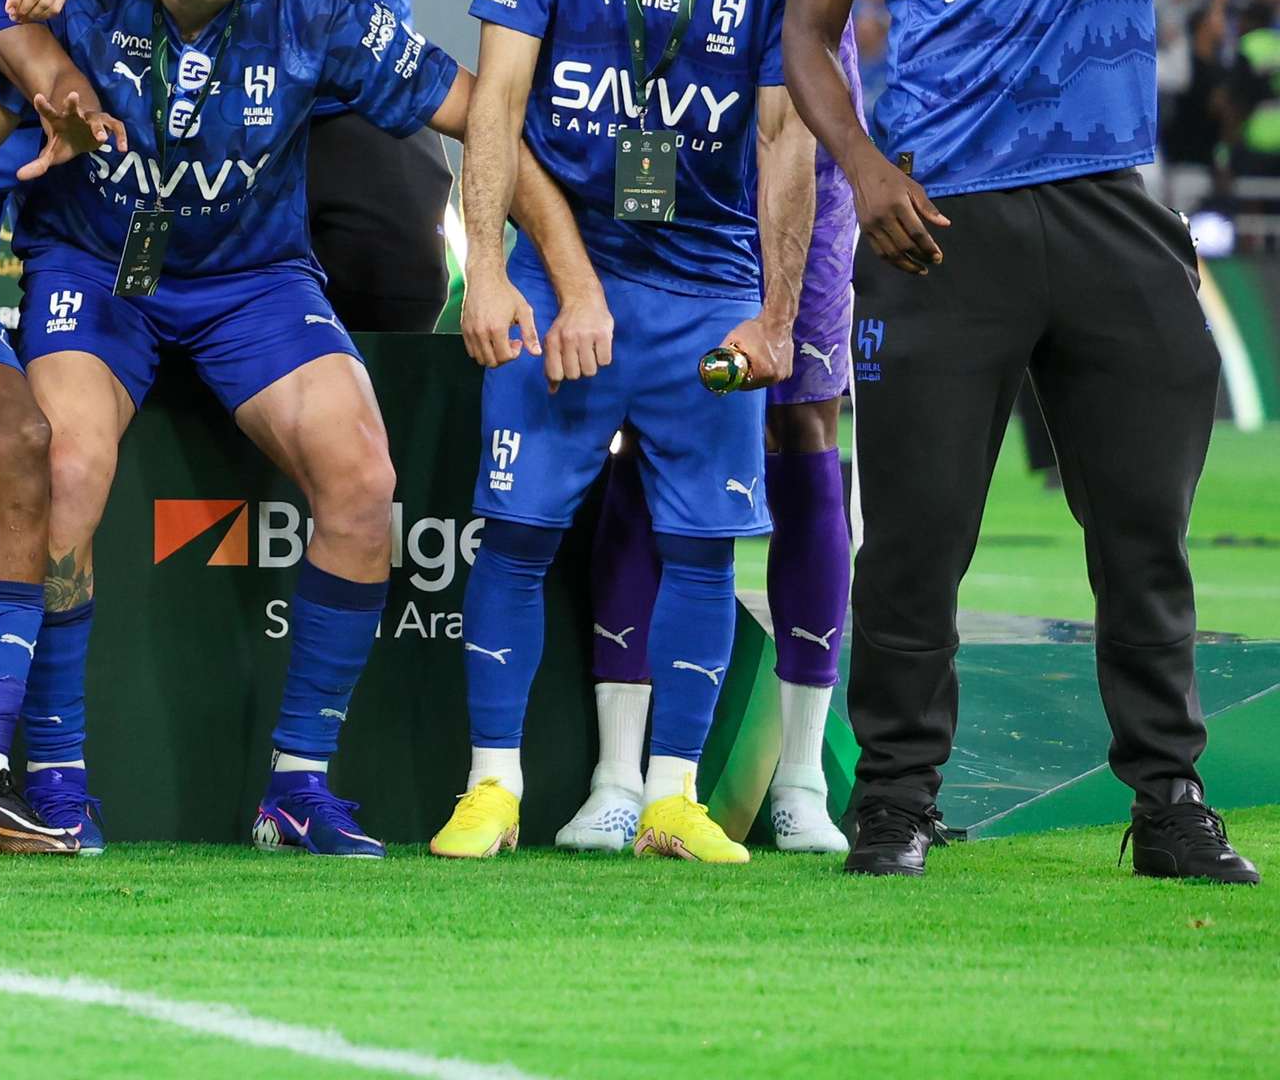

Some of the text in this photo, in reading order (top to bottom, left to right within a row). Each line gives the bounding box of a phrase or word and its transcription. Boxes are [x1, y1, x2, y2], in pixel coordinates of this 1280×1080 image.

[361, 22, 379, 48] Red
[243, 107, 274, 117] ALHILAL
[552, 60, 740, 133] SAVVY
[675, 134, 723, 153] OUP
[90, 144, 271, 201] SAVVY
[89, 170, 145, 211] GAME
